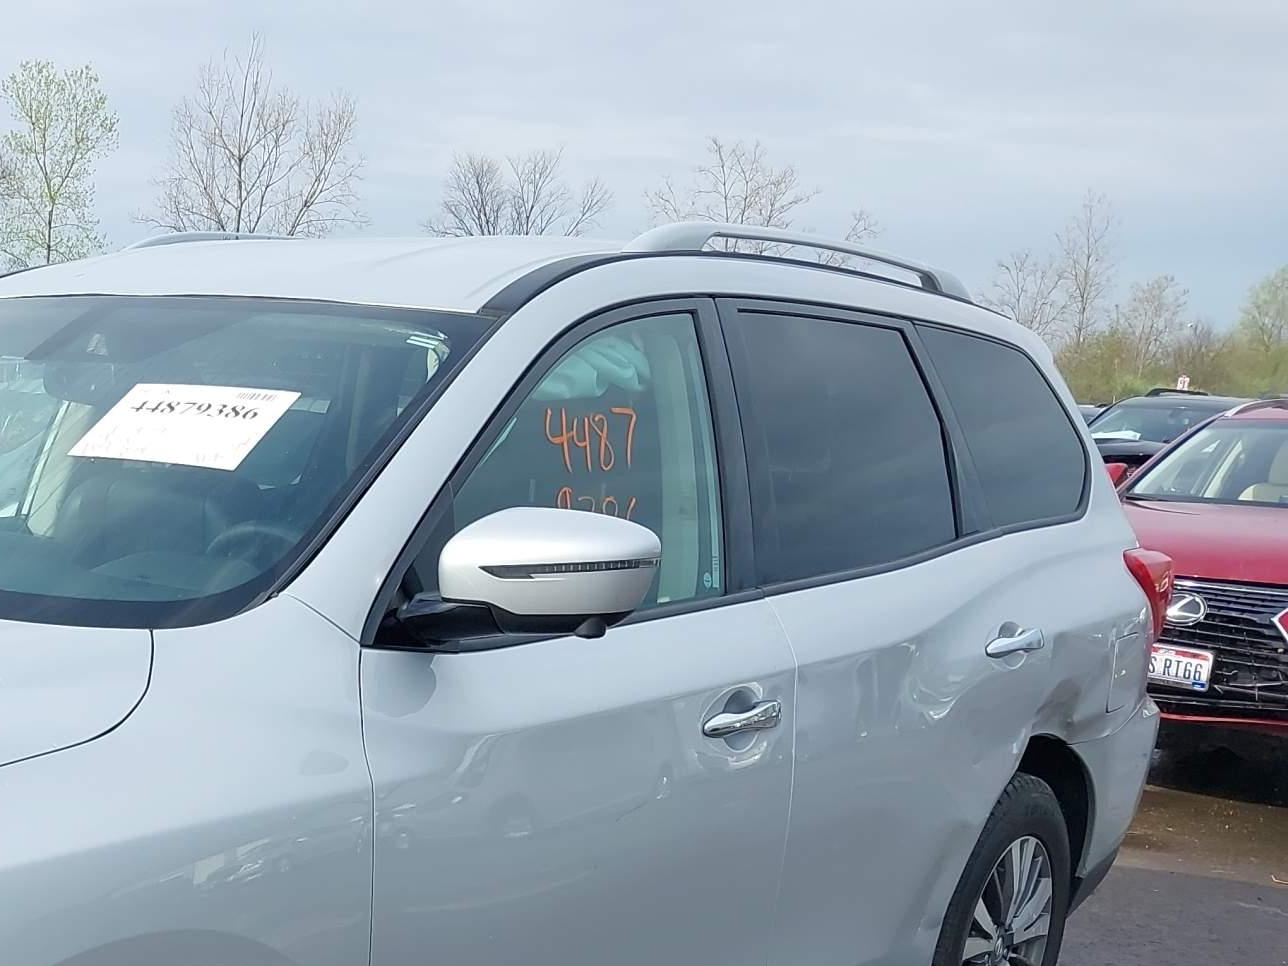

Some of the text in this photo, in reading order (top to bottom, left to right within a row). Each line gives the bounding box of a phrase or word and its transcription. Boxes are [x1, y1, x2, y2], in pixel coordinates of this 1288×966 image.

[130, 399, 260, 421] 44879386
[544, 407, 638, 474] 4487
[1162, 658, 1203, 682] RT66
